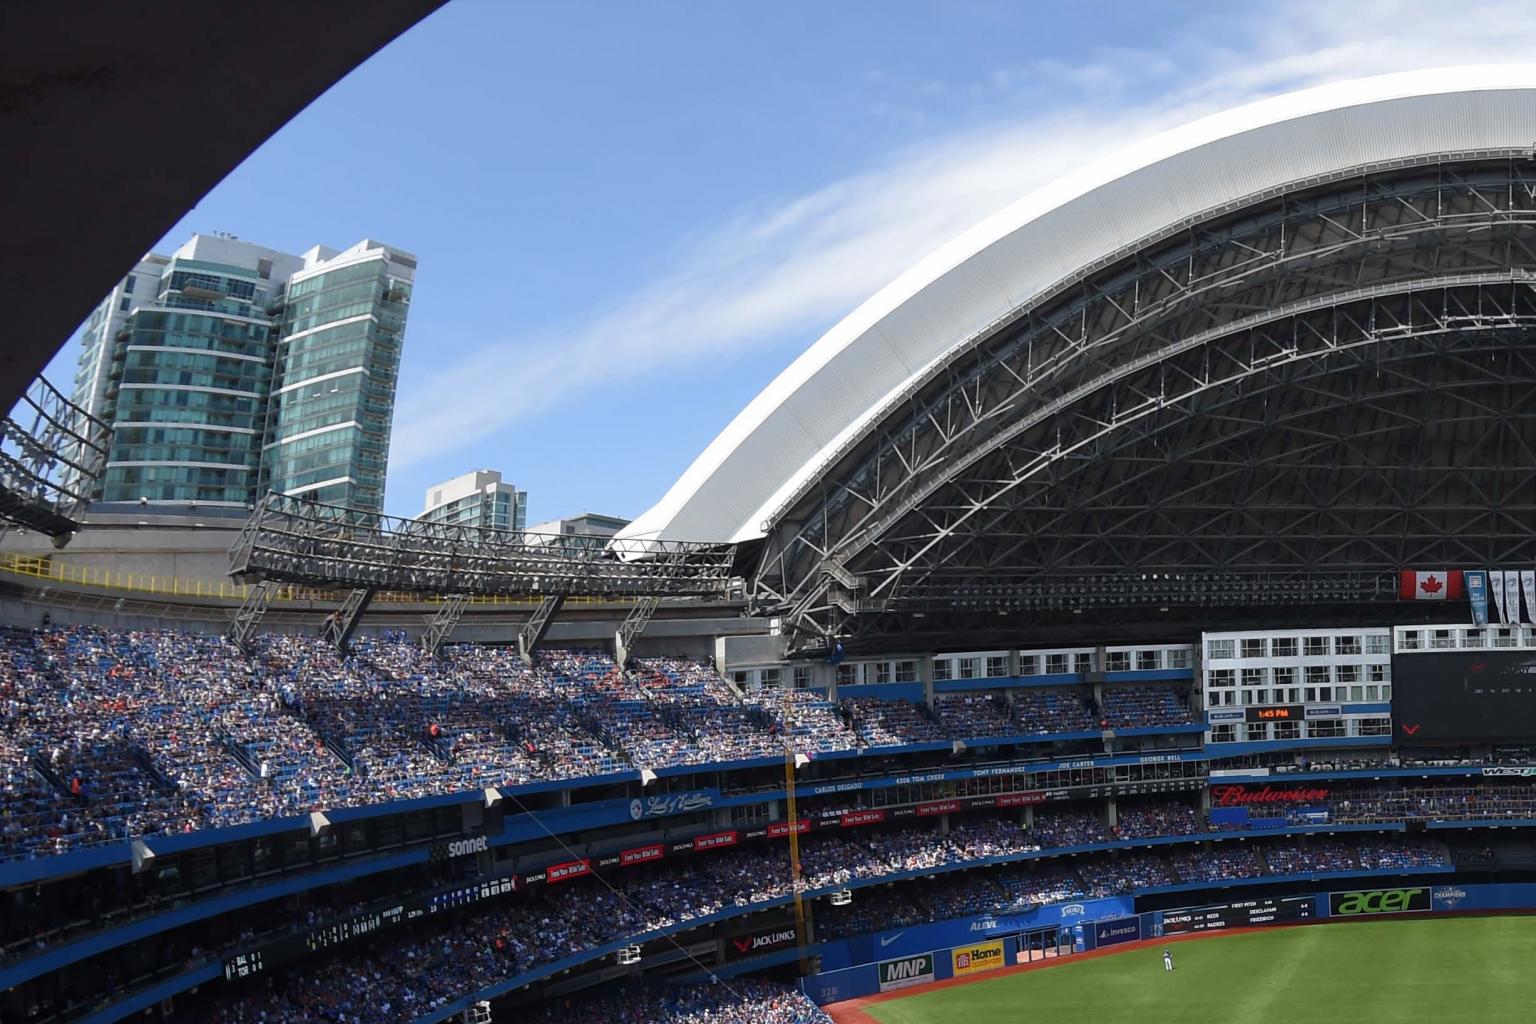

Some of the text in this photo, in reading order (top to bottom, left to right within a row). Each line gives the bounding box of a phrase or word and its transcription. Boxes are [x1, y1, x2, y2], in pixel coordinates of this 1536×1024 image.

[1259, 709, 1289, 718] 1:45 PM
[973, 769, 990, 777] TONY
[815, 782, 862, 793] CARLOS DELGADO
[1213, 785, 1328, 805] Budweiser
[449, 835, 488, 858] sonnet
[1338, 889, 1422, 914] acer
[969, 920, 998, 932] ALEVE
[1110, 925, 1136, 936] invesco
[752, 934, 772, 949] JACK
[971, 946, 1001, 960] Home
[238, 966, 249, 977] TOR
[887, 958, 926, 982] MNP
